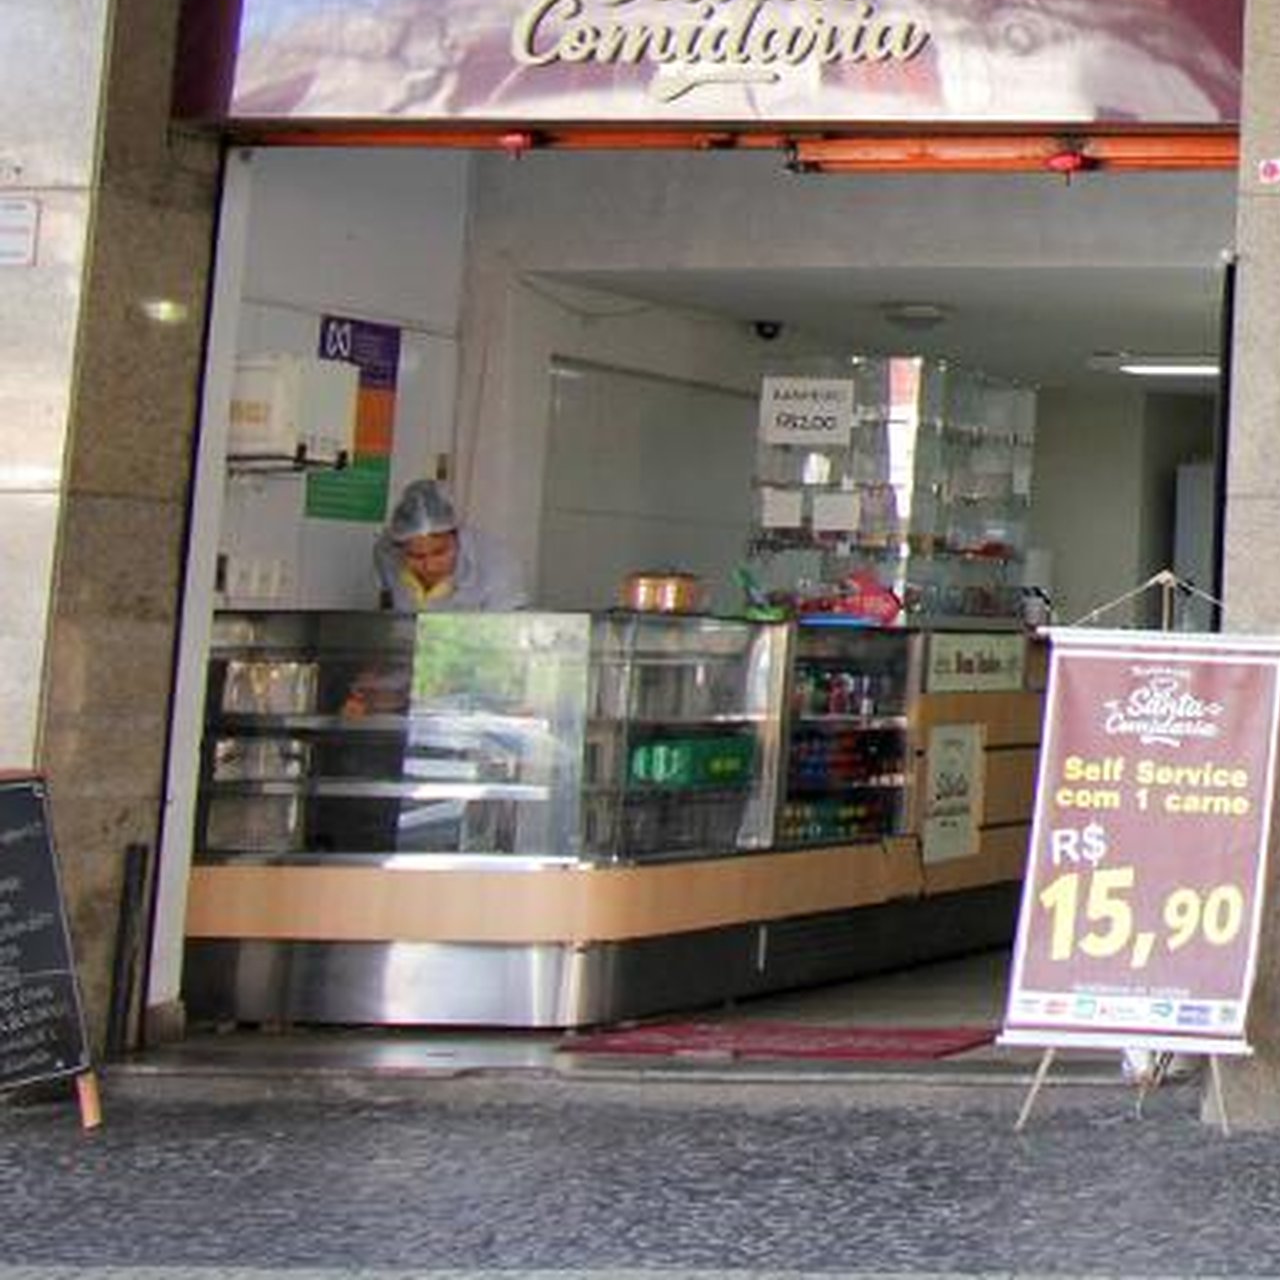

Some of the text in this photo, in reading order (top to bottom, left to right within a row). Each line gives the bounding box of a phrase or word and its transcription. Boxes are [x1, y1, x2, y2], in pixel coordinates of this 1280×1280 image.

[1064, 756, 1250, 790] Self Service
[1055, 786, 1252, 817] com 1 carne
[1049, 823, 1108, 869] R$
[1038, 865, 1245, 969] 15,90
